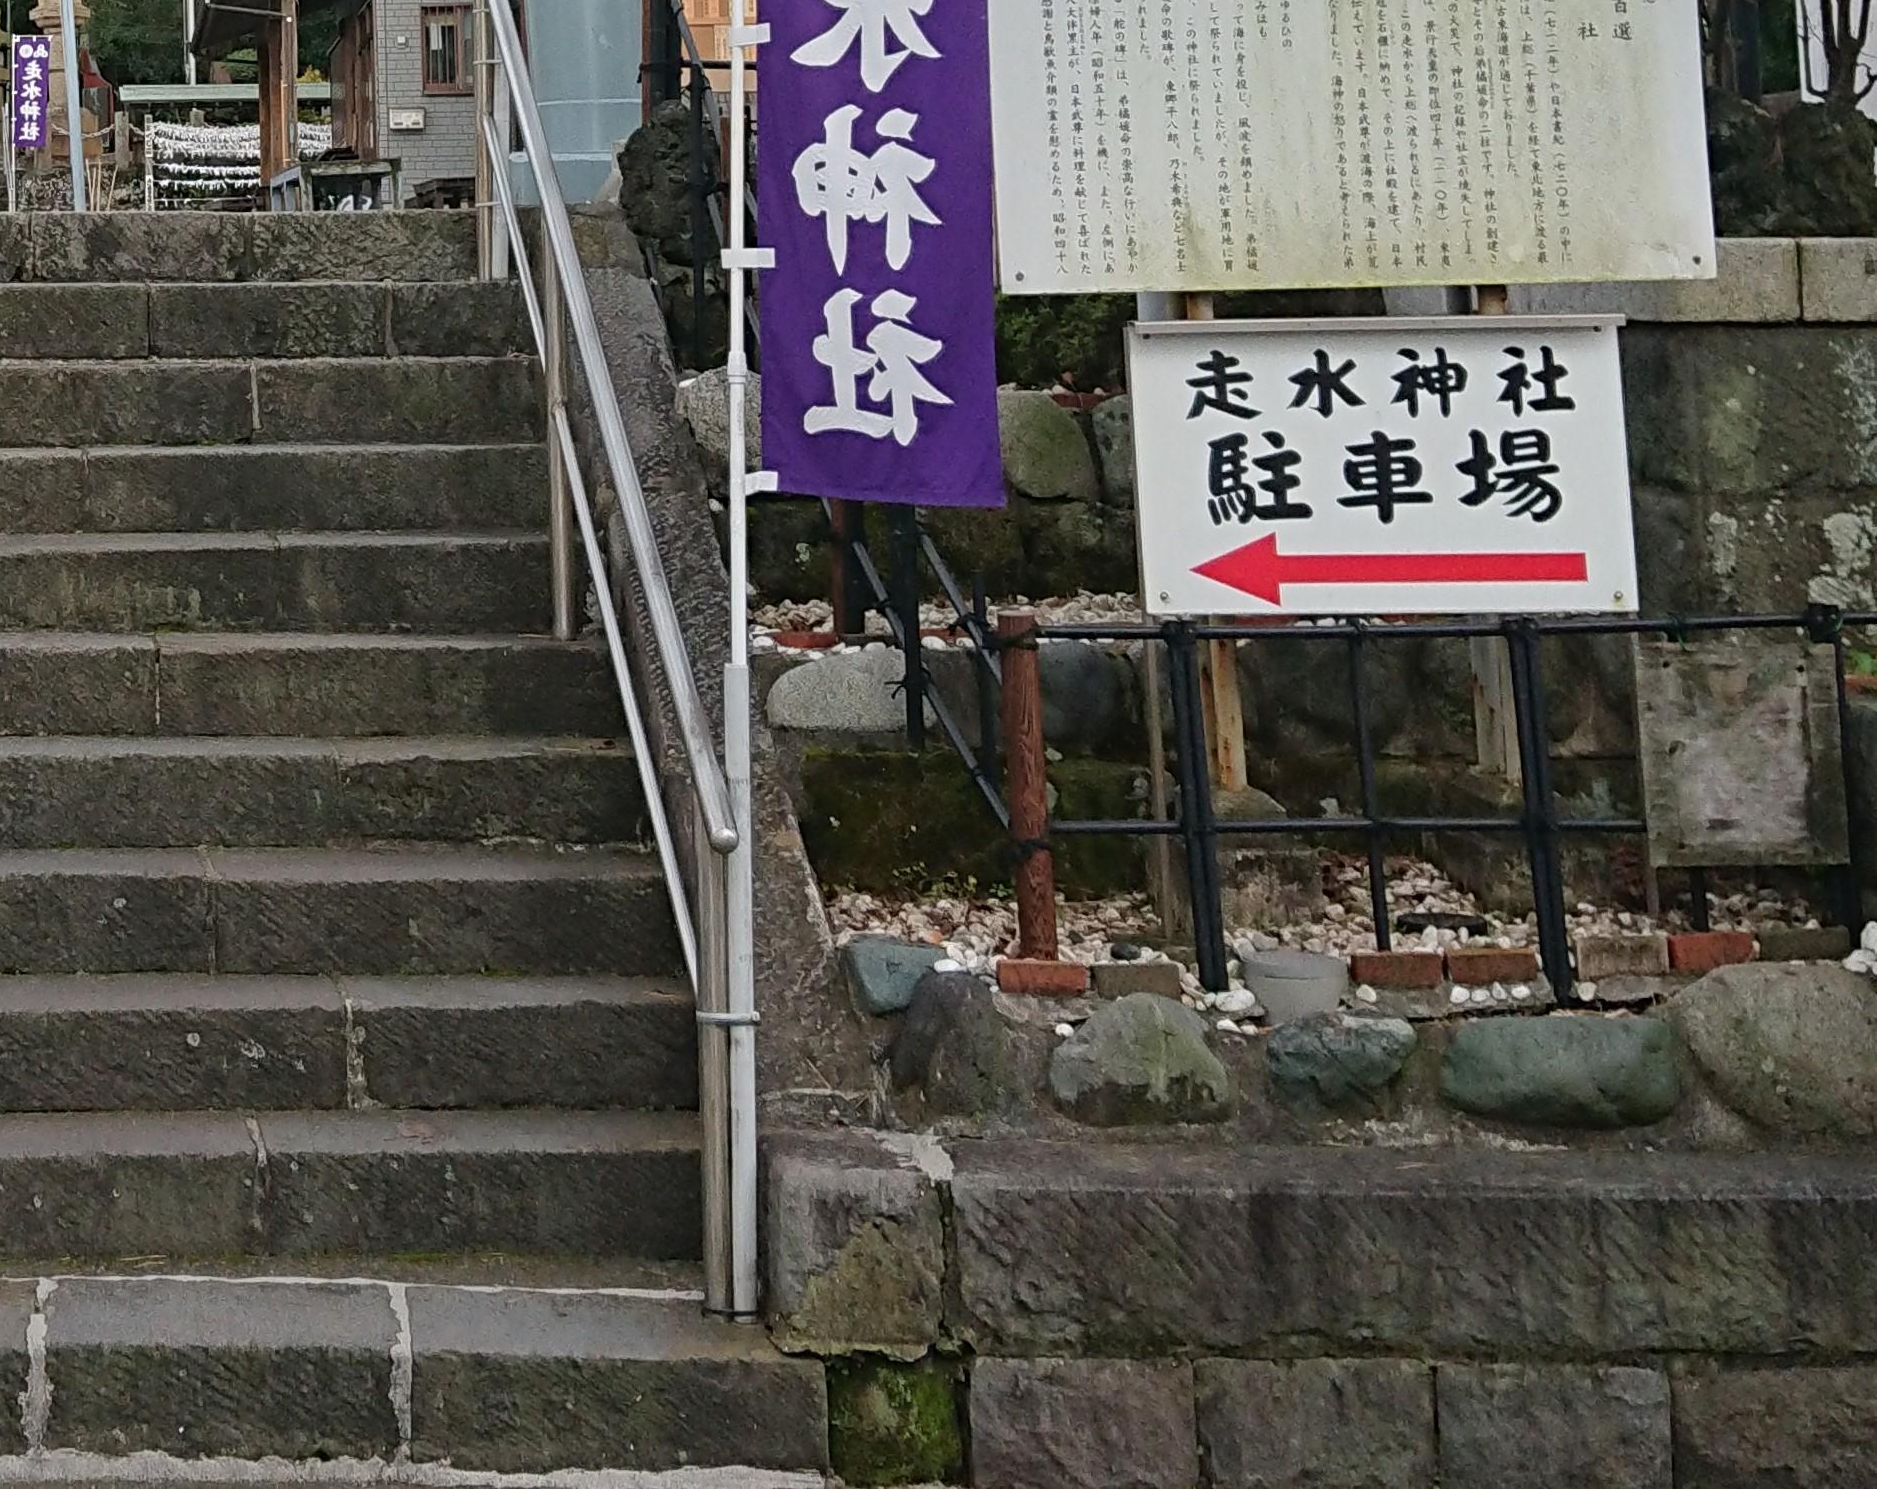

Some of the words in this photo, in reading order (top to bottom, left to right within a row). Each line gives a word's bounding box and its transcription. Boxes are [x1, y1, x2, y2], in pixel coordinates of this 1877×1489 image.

[1185, 345, 1576, 420] 走水神社
[1207, 430, 1563, 525] 駐車場
